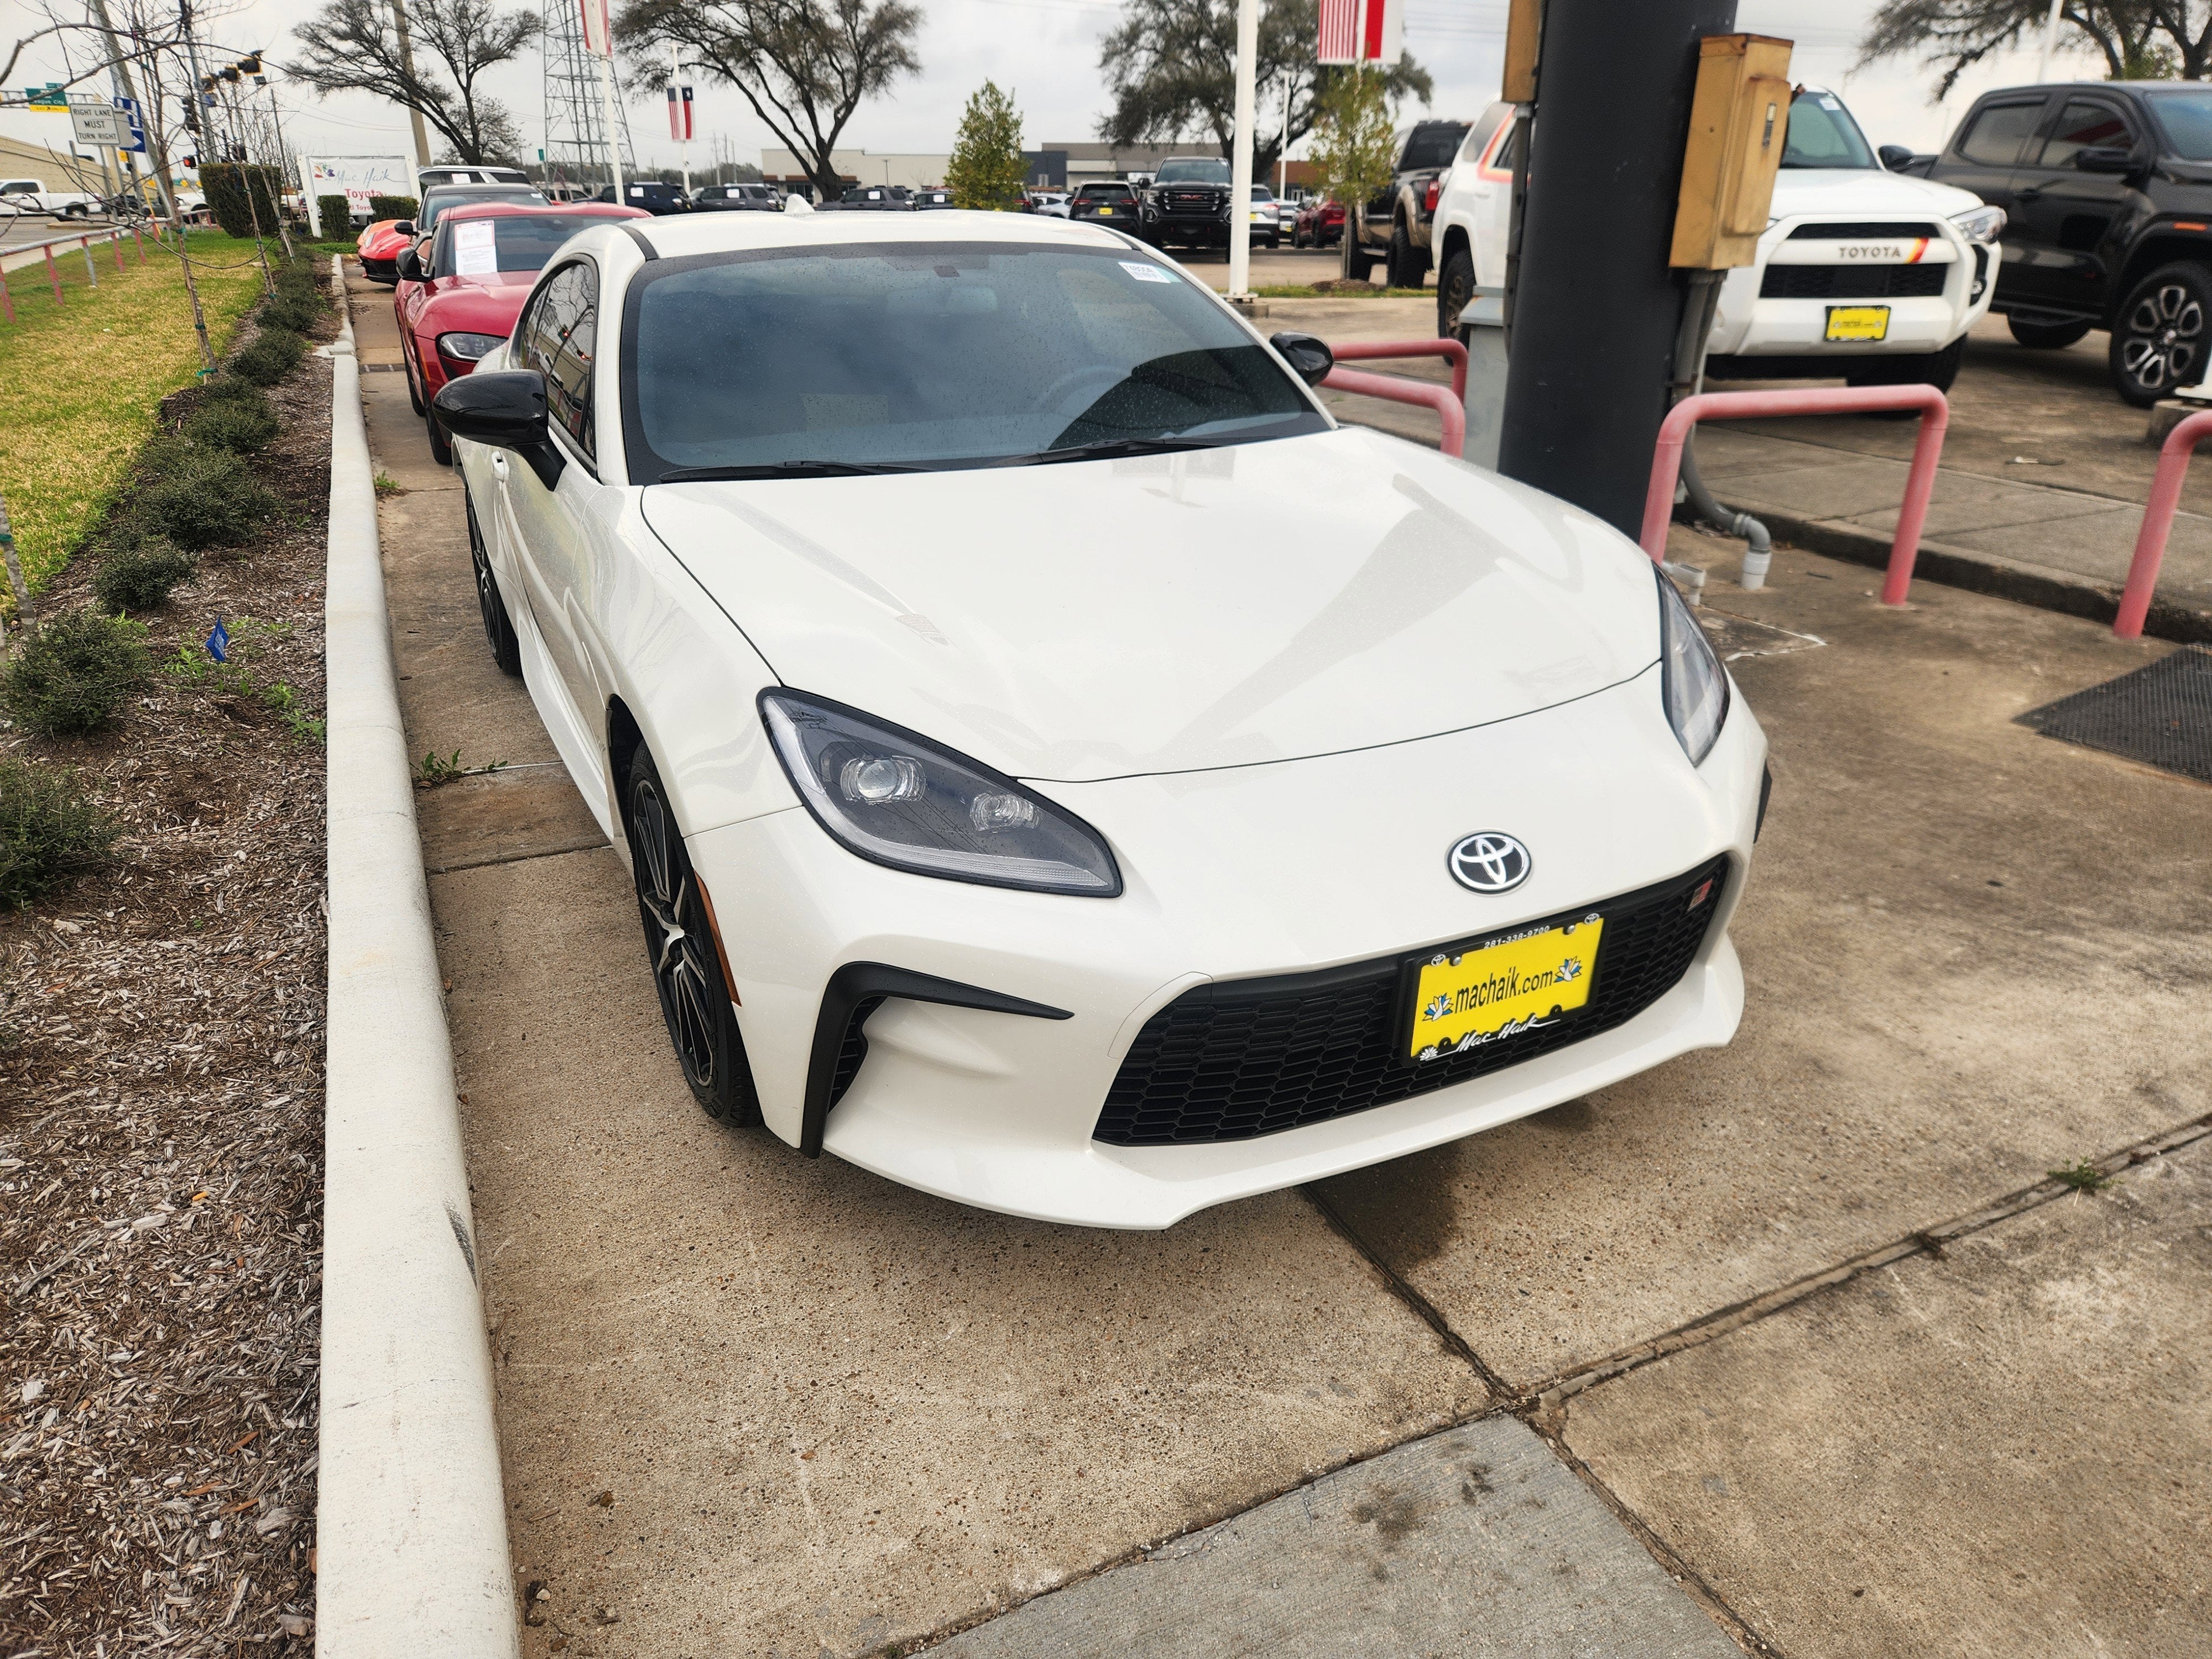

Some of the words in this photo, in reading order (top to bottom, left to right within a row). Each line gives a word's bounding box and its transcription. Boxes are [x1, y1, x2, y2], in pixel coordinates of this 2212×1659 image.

[84, 120, 105, 128] MUST
[335, 169, 359, 189] Mac
[363, 167, 408, 189] Haik
[345, 189, 383, 201] Toyota
[1839, 247, 1901, 258] TOYOTA
[1484, 925, 1551, 950] 281-338-9700
[1454, 966, 1553, 1014] machaik.com
[1455, 1031, 1496, 1053] Mac
[1497, 1016, 1561, 1040] Haik
